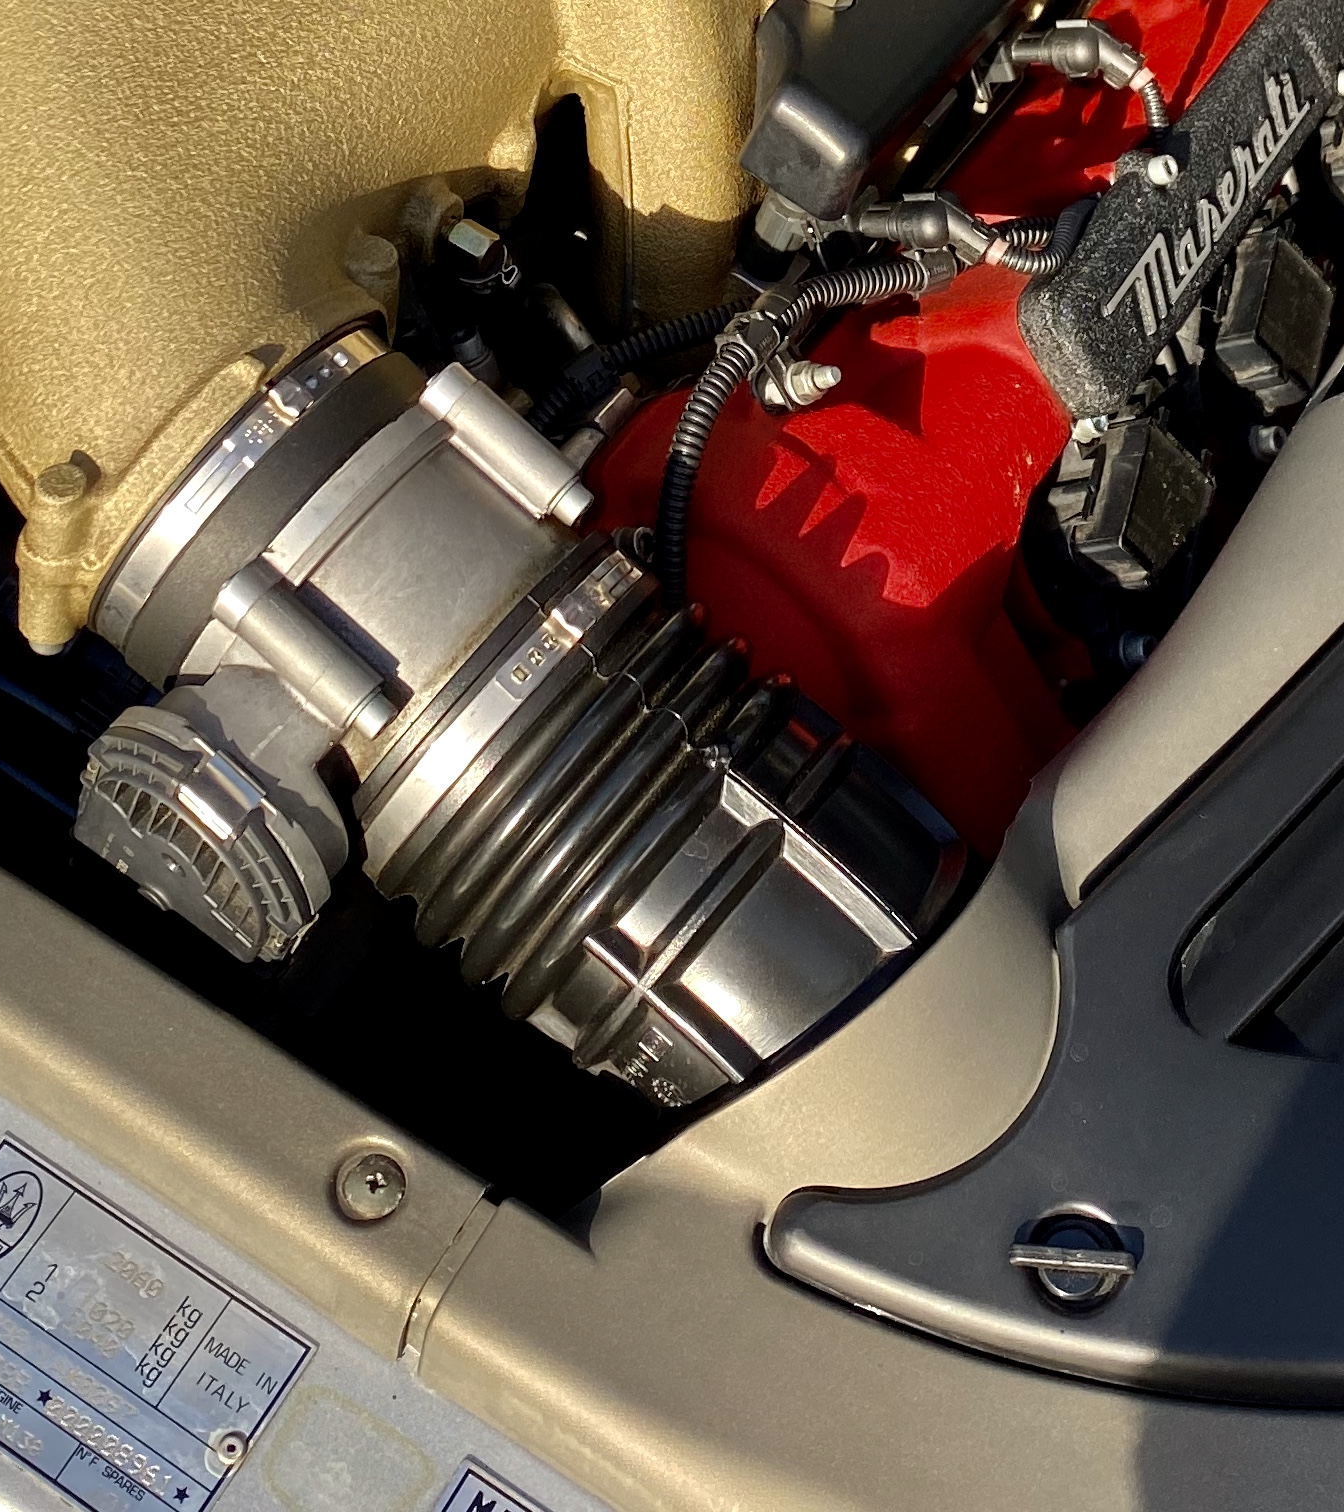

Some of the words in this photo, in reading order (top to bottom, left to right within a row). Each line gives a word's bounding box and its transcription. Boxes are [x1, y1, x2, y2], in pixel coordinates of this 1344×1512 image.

[1101, 69, 1316, 336] Maserati
[26, 1281, 45, 1302] 2
[134, 1354, 163, 1389] kg
[46, 1262, 58, 1281] 1
[149, 1334, 176, 1369] kg
[163, 1315, 190, 1349] kg
[177, 1296, 203, 1329] kg
[204, 1337, 252, 1376] MADE
[255, 1372, 279, 1395] IN
[196, 1371, 250, 1414] ITALY
[101, 1465, 146, 1501] SPARES
